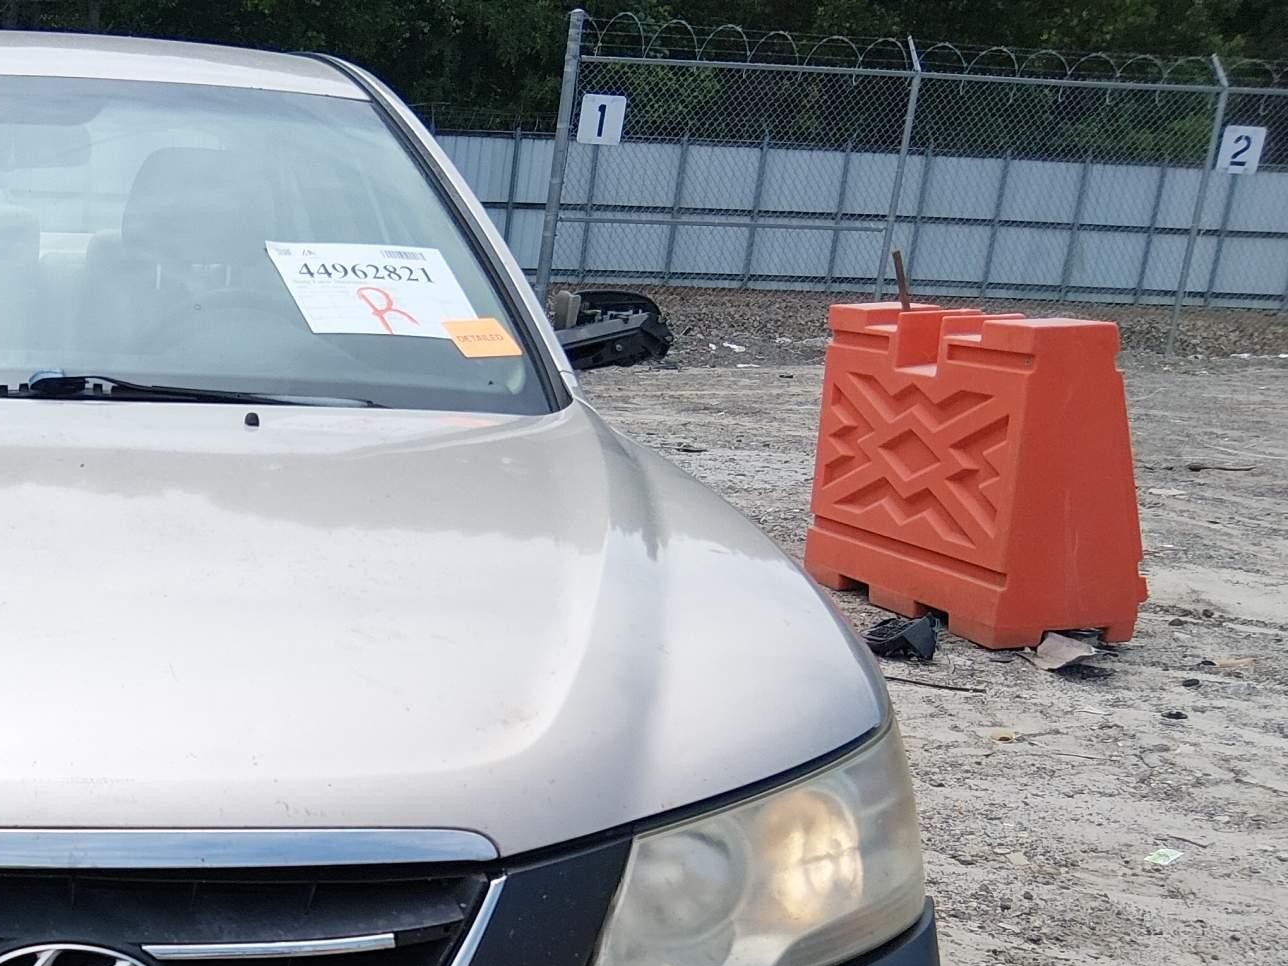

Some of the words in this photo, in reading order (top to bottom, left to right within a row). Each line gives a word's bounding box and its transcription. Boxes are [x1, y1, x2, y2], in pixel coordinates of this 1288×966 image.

[597, 103, 607, 137] 1
[1230, 135, 1251, 166] 2
[299, 262, 434, 283] 44962821
[356, 286, 421, 334] R
